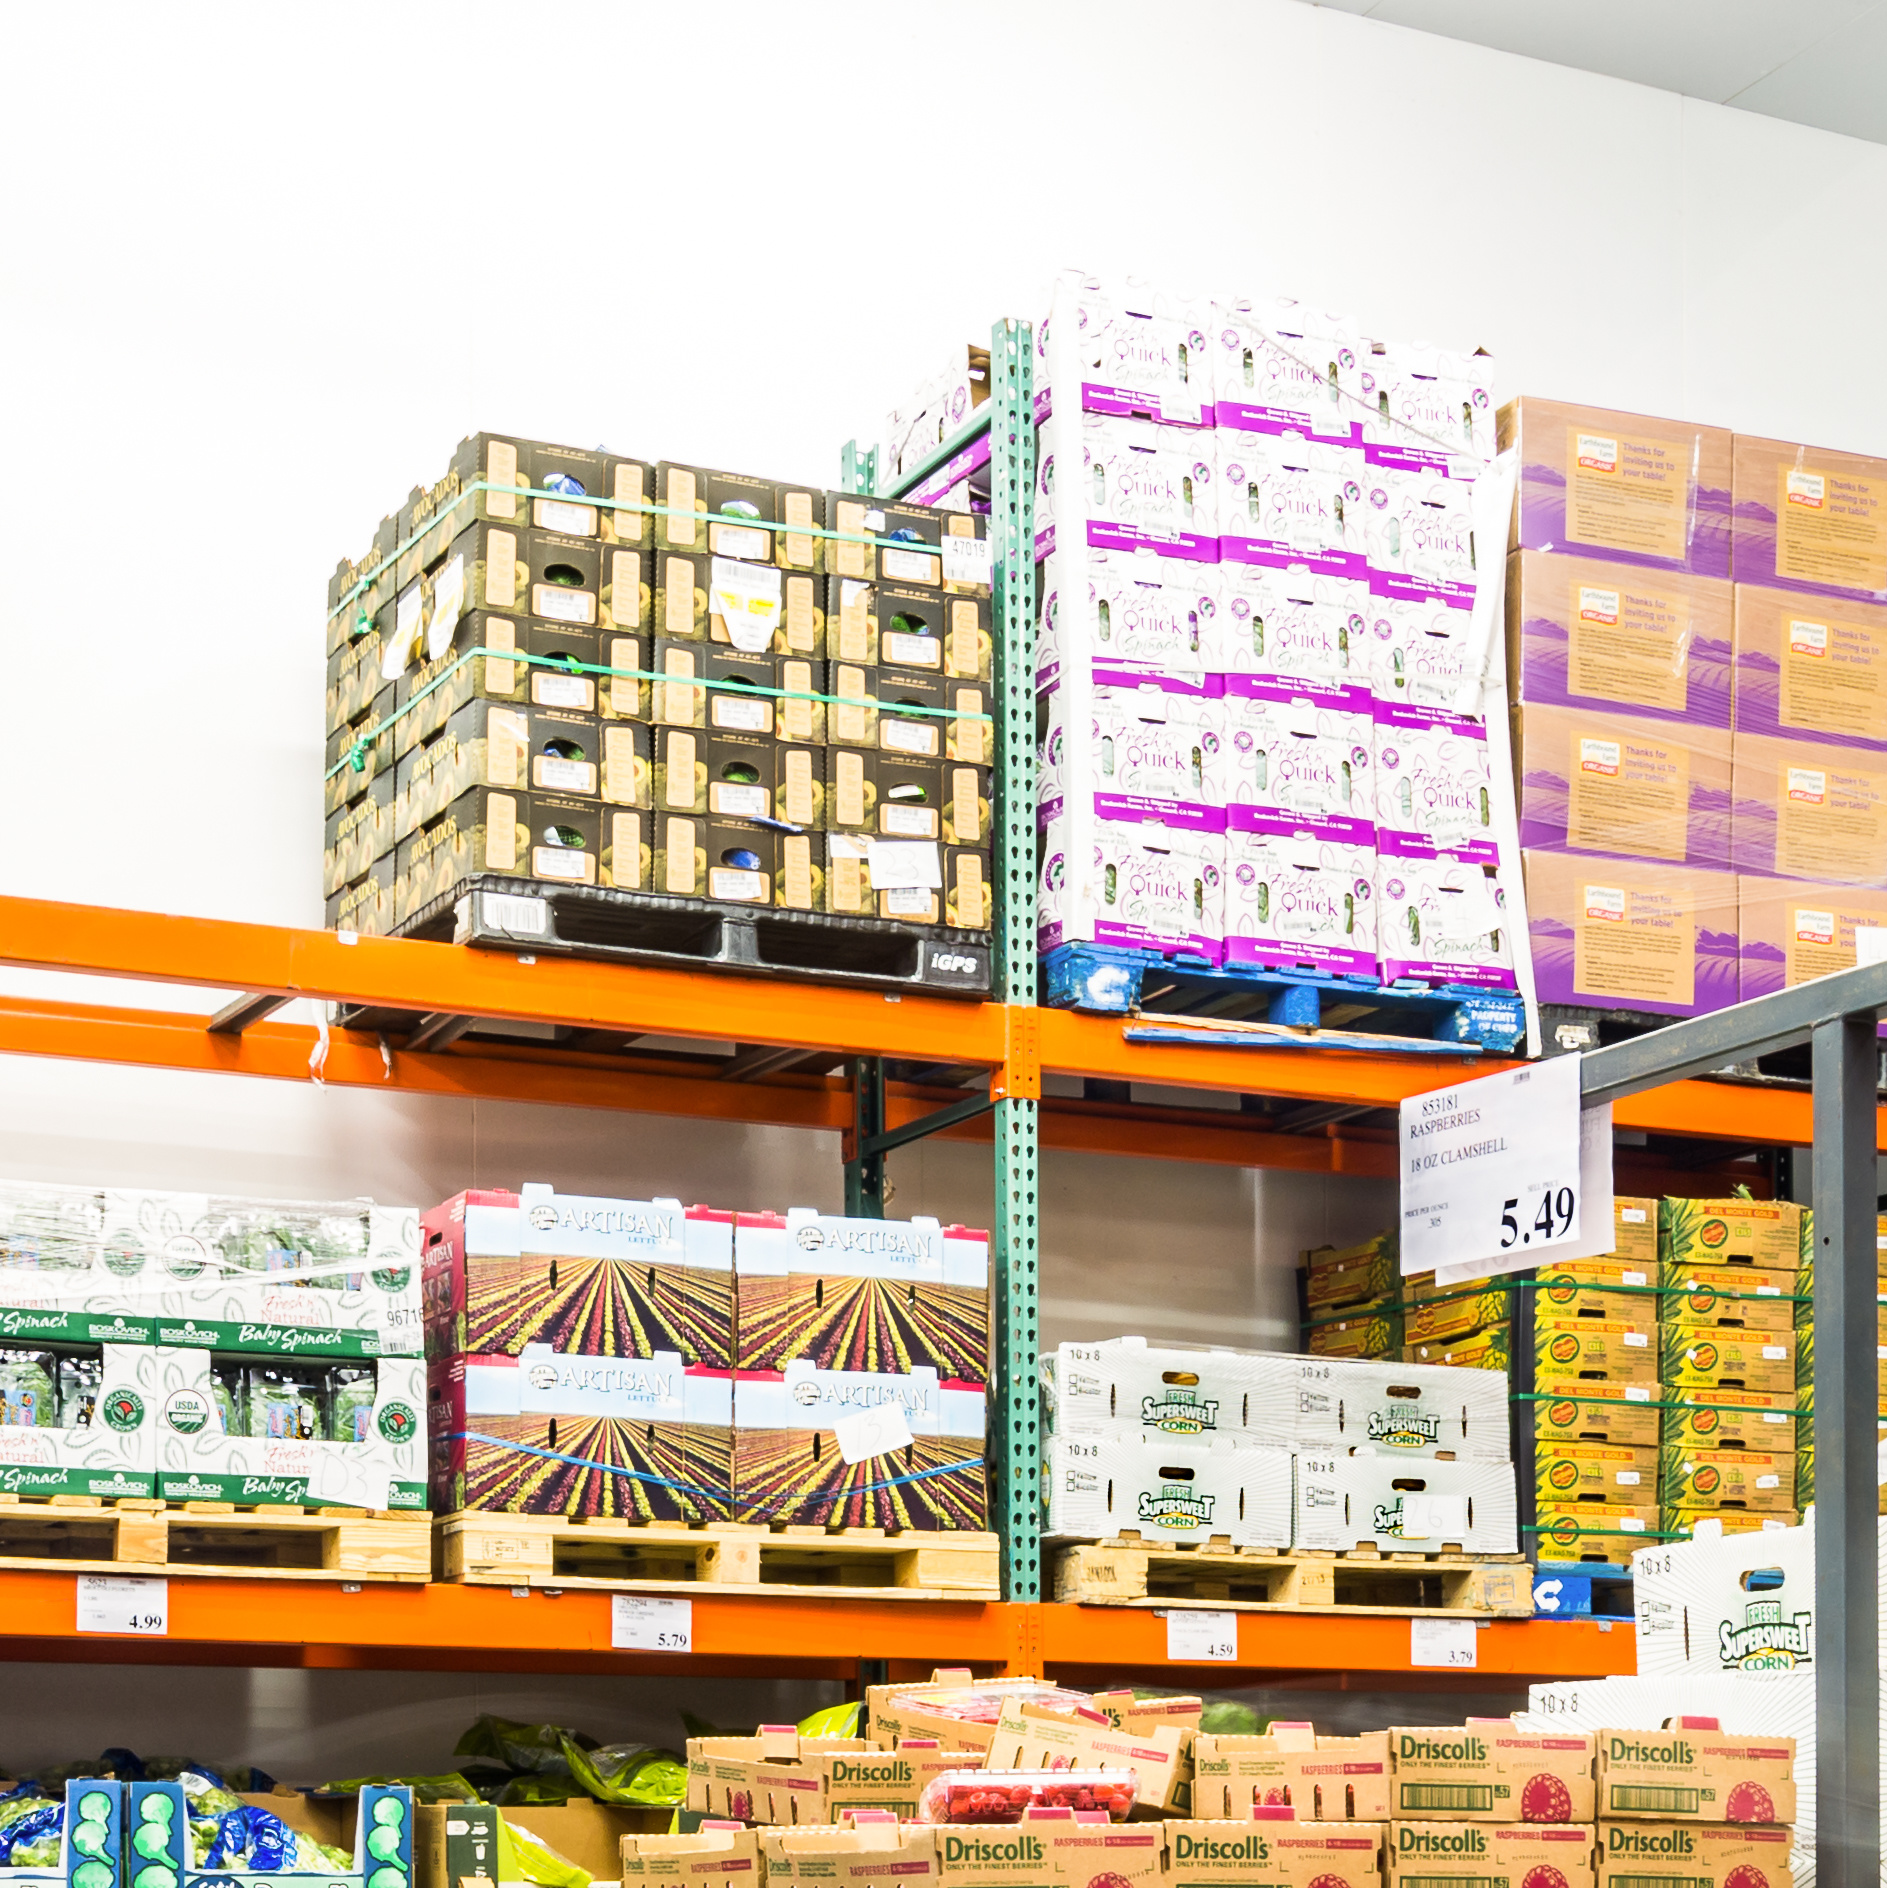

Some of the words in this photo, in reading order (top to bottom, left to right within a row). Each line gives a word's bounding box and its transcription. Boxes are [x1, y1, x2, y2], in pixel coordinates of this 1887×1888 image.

[952, 538, 984, 557] 47019
[1422, 788, 1476, 811] Quick
[413, 815, 457, 860] AVOCADOS
[931, 953, 977, 974] iGPS
[1421, 1093, 1459, 1117] 853181
[1410, 1107, 1480, 1140] RASPBERRIES
[1411, 1158, 1421, 1174] 18
[1423, 1153, 1438, 1171] OZ
[1440, 1137, 1507, 1167] CLAMSHELL
[561, 1208, 673, 1240] ARTISAN
[1500, 1186, 1576, 1249] 5.49
[628, 1236, 669, 1245] LETTUCE
[6, 1313, 70, 1336] Spinach
[129, 1615, 162, 1629] 4.99
[657, 1631, 688, 1647] 5.79
[1207, 1643, 1233, 1657] 4.59
[1448, 1650, 1473, 1664] 3.79
[1176, 1834, 1268, 1861] Driscoll's
[1277, 1839, 1324, 1848] RASPBERRIES
